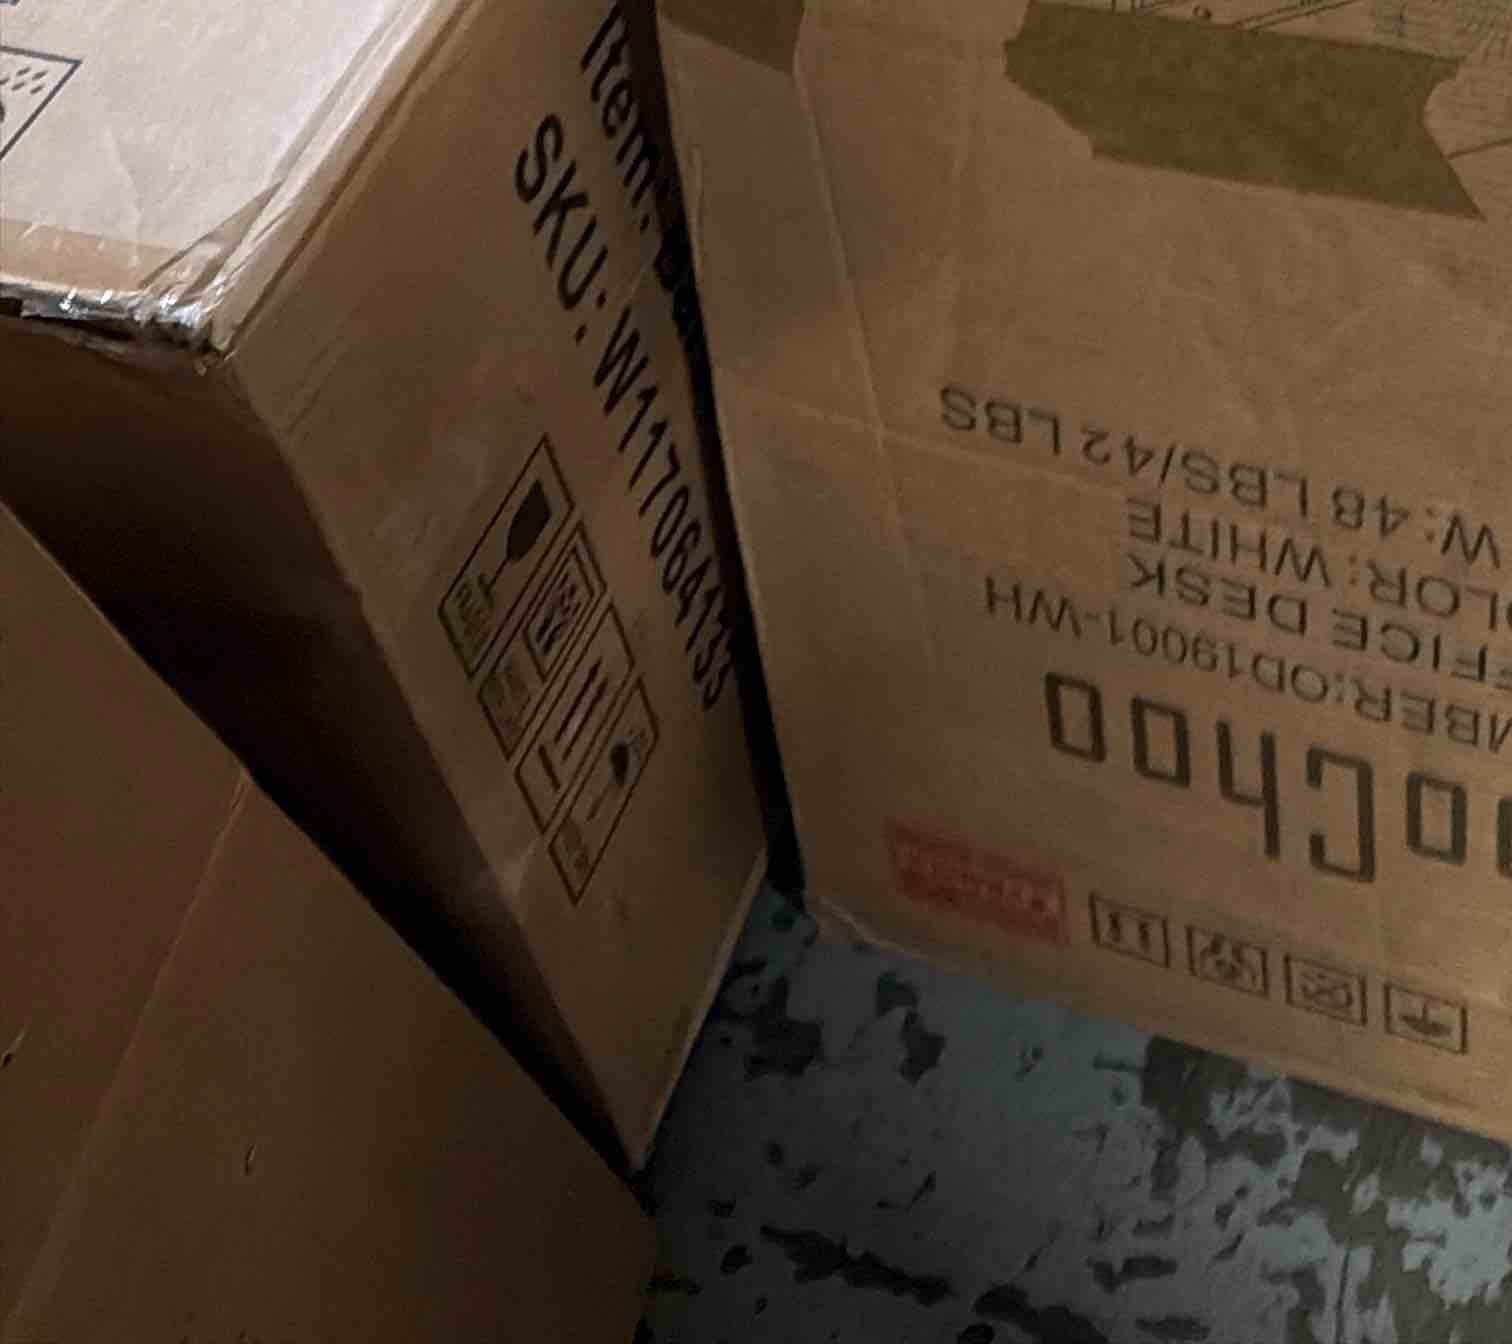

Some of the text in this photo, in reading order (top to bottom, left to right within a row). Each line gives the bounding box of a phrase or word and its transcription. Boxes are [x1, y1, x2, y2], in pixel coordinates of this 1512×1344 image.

[515, 114, 608, 346] SKU:
[594, 307, 734, 710] W117064133
[939, 383, 1062, 457] LBS
[1081, 426, 1309, 518] LBS/42
[1127, 553, 1308, 637] DESK
